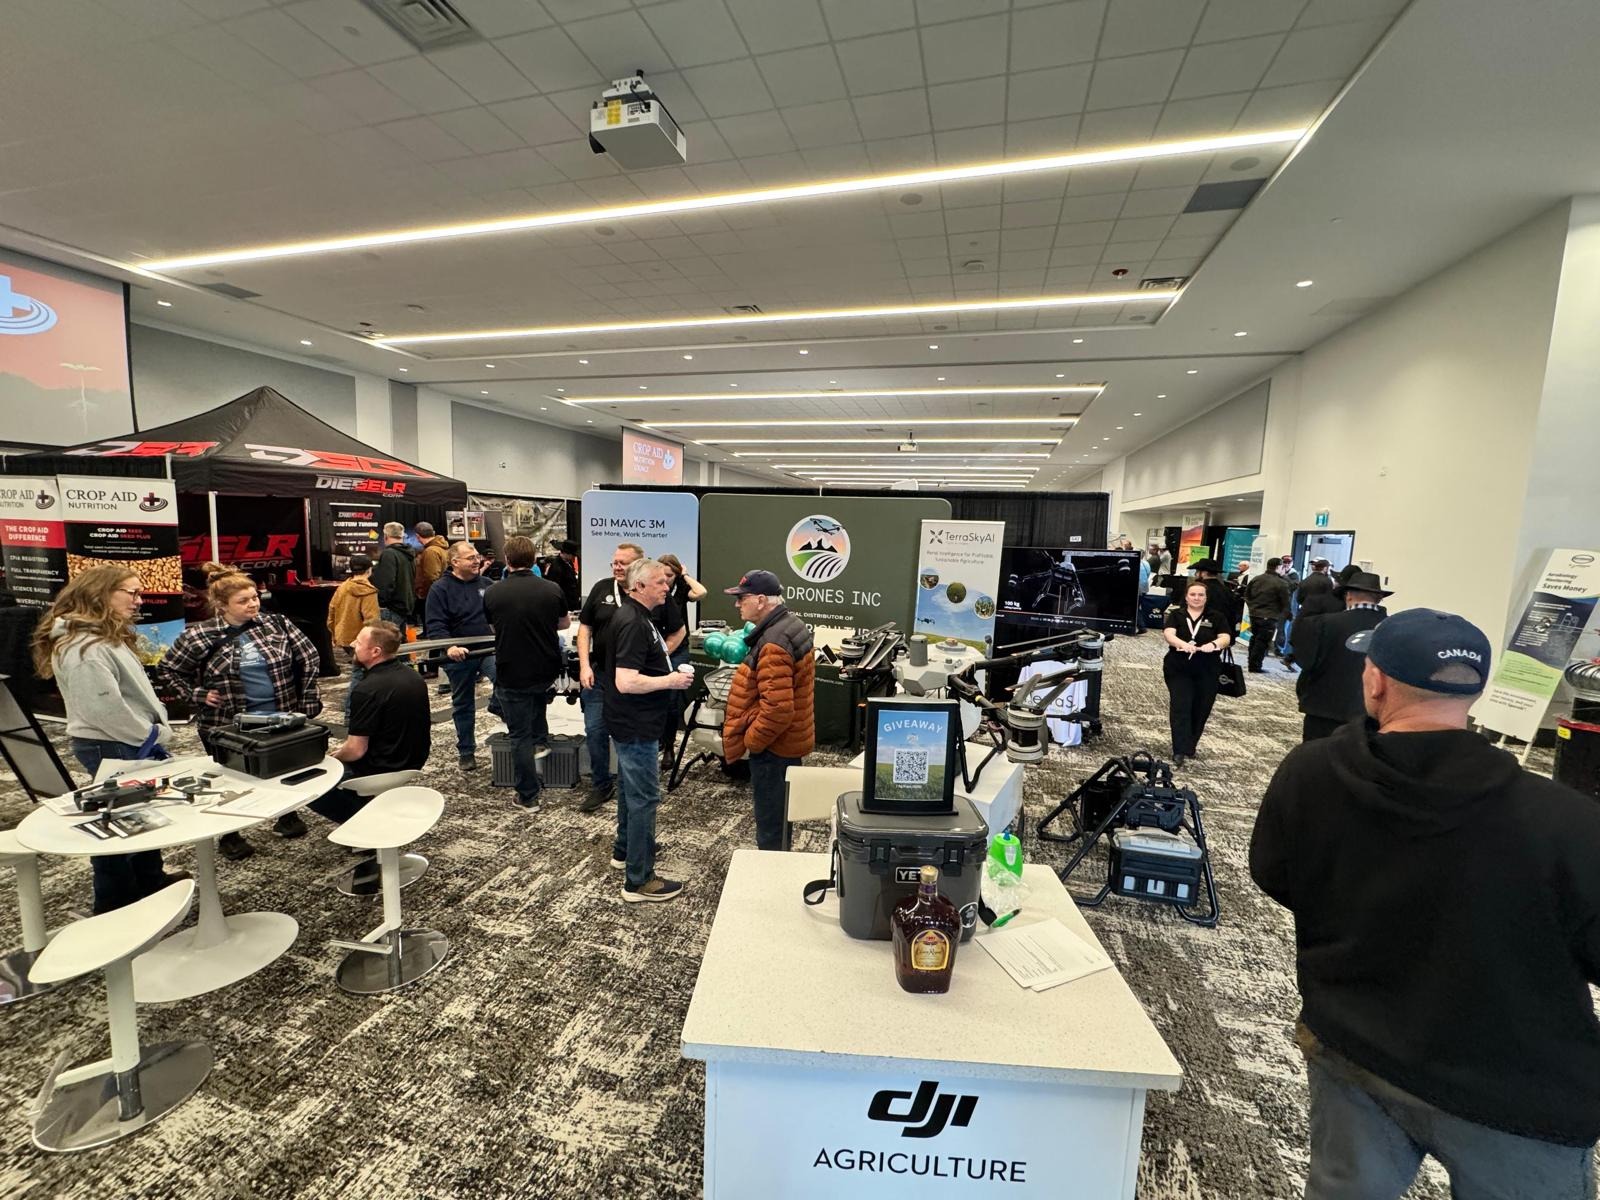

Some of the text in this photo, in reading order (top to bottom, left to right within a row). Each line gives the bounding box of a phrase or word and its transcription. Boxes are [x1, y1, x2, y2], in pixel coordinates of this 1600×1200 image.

[0, 489, 35, 500] ROP AID
[66, 489, 138, 502] CROP AID
[68, 502, 117, 510] NUTRITION
[590, 517, 665, 529] DJI MAVIC 3M
[37, 526, 49, 534] AID
[8, 533, 47, 542] DIFFERENCE
[945, 531, 995, 544] TerraSkyAI
[1562, 584, 1588, 593] Money
[786, 586, 882, 607] DRONES INC
[803, 612, 844, 620] DISTRIBUTOR
[1437, 648, 1482, 663] CANADA
[883, 719, 943, 734] GIVEAWAY
[813, 1147, 1027, 1183] AGRICULTURE
